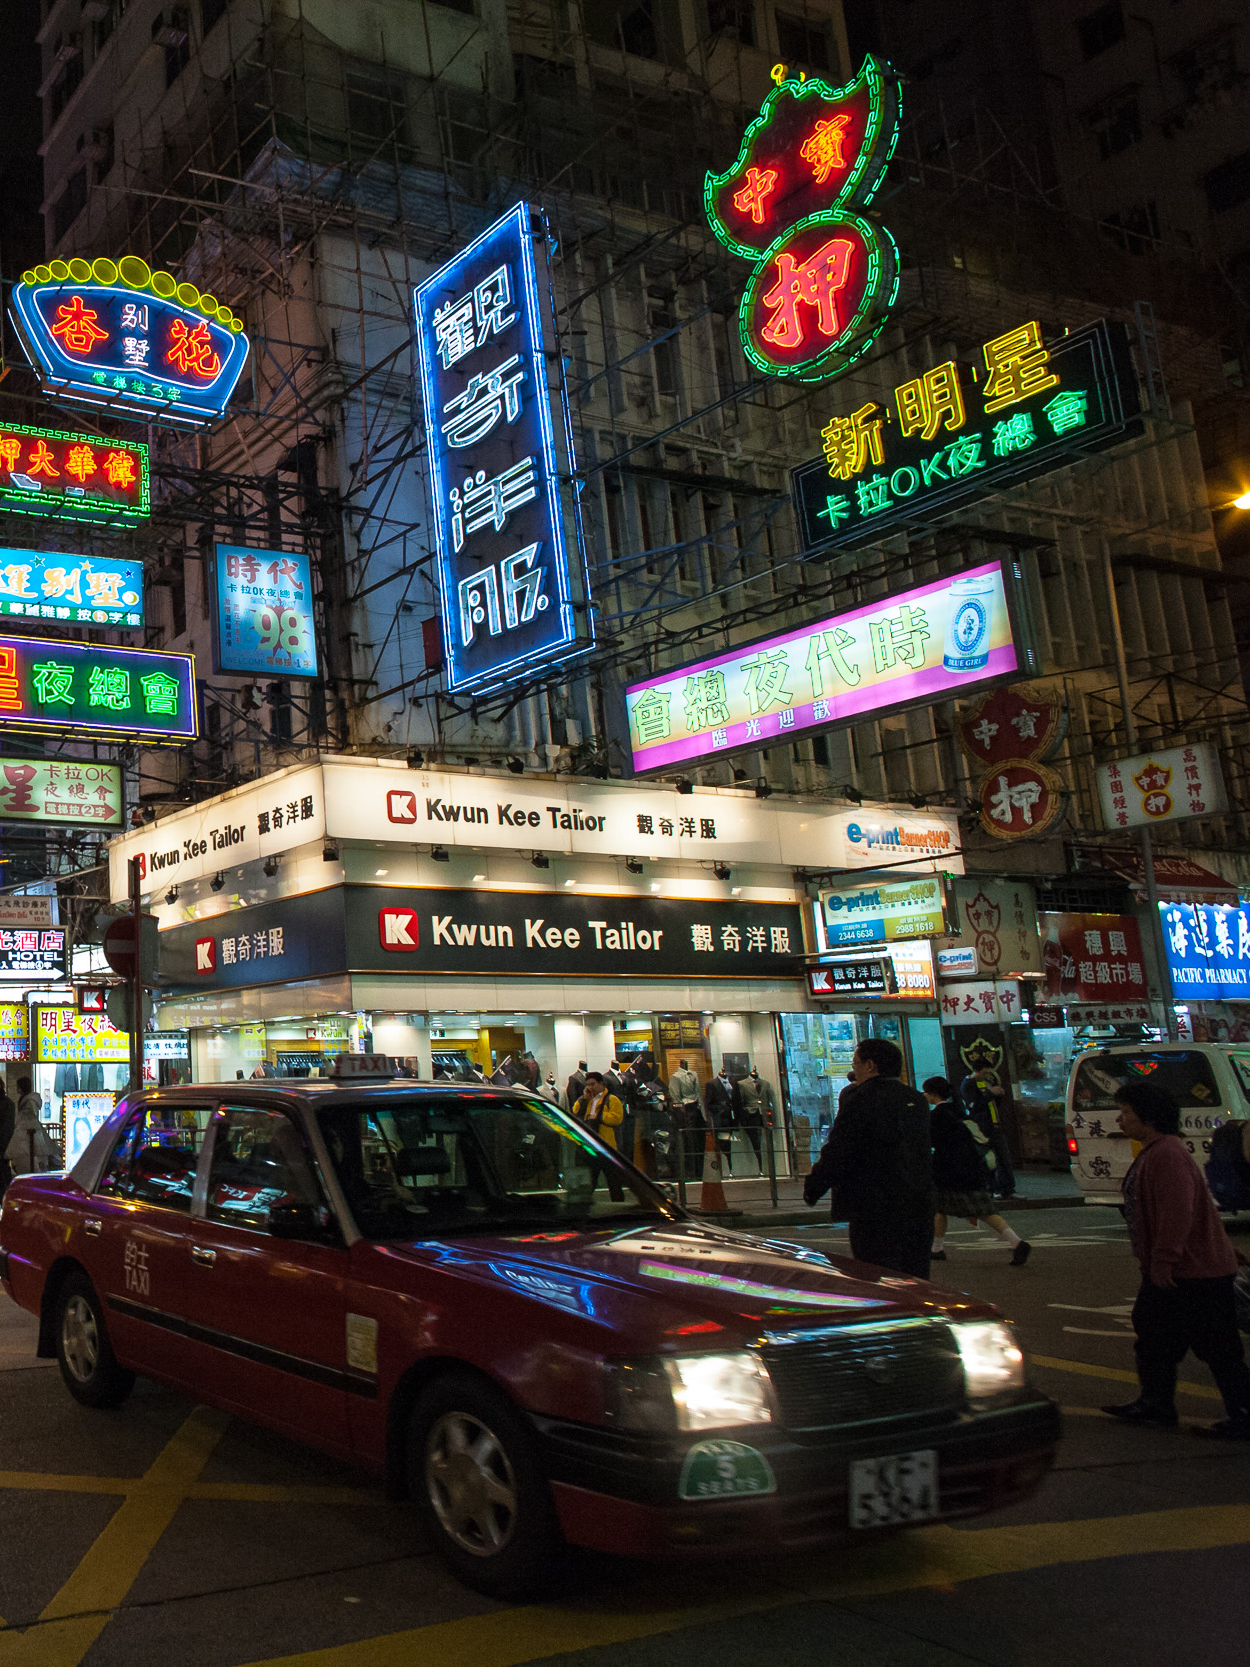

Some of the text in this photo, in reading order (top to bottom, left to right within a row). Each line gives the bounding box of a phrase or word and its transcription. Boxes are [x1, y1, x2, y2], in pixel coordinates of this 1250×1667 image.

[762, 239, 855, 348] 押
[821, 320, 1061, 481] 新明星
[432, 262, 550, 648] 觀奇洋服
[226, 554, 304, 590] 時代
[947, 658, 964, 667] BLUE
[43, 763, 113, 783] 卡拉OK
[44, 781, 114, 803] 夜總會
[989, 774, 1043, 825] 押
[1146, 792, 1167, 814] 押
[257, 795, 314, 835] 觀奇洋服
[426, 797, 606, 832] Kwun Kee Tailor
[636, 813, 718, 840] 觀奇洋服
[150, 824, 246, 872] Kwun Kee Tailor
[431, 915, 663, 951] Kwun Kee Tailor
[690, 925, 792, 954] 觀奇洋服
[838, 928, 874, 941] 2344 6638
[895, 921, 935, 934] 2988 1618
[8, 951, 63, 961] HOTEL
[221, 926, 285, 966] 觀奇洋服
[938, 951, 973, 962] e-print
[980, 936, 995, 961] 押
[833, 964, 882, 980] 觀奇洋服
[867, 980, 884, 988] Tailor
[907, 973, 930, 987] 8080
[1078, 960, 1144, 985] 超級市場
[1171, 967, 1247, 985] PACIFIC PHARMACY
[1034, 1012, 1057, 1023] CS5
[350, 1056, 390, 1073] TAXI
[123, 1239, 150, 1271] 的士
[123, 1264, 150, 1296] TAXI
[696, 1477, 760, 1496] SEATS
